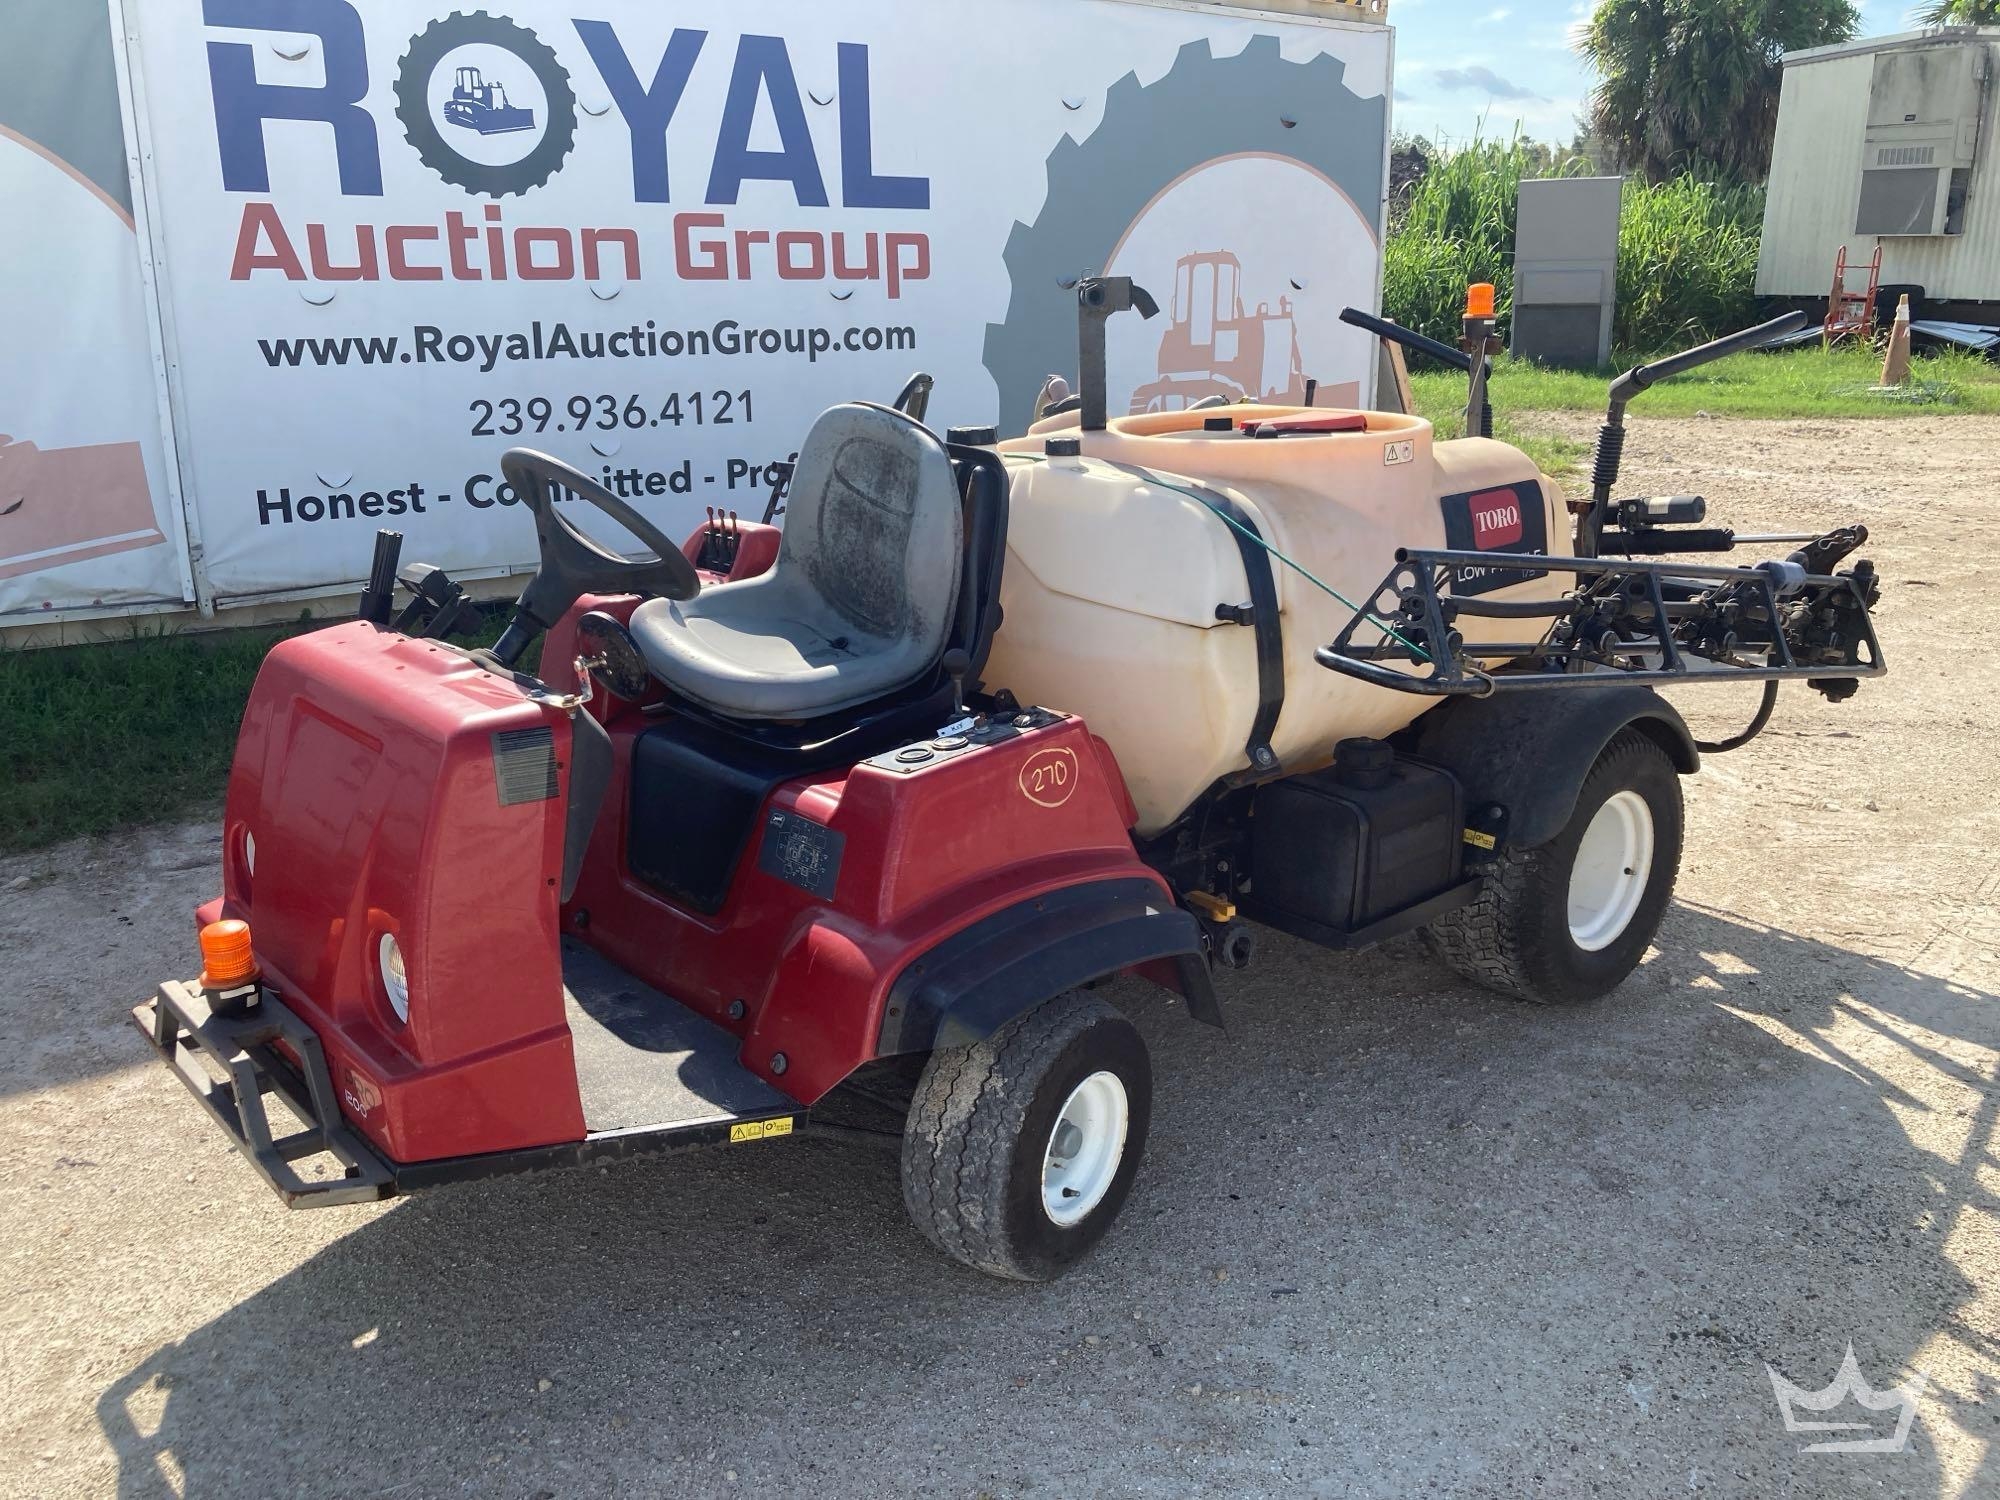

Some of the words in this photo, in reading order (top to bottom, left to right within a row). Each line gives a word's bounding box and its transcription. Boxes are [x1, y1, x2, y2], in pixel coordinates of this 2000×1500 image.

[203, 0, 930, 210] ROYAL
[229, 202, 641, 281] Auction
[673, 213, 930, 299] Group
[257, 320, 916, 372] www.RoyalAuctionGroup.com
[469, 390, 753, 436] 239.936.4121
[256, 483, 426, 525] Honest
[464, 460, 692, 509] Coitted
[1475, 505, 1518, 532] TORO
[1457, 566, 1486, 582] LOW
[1031, 761, 1067, 792] 270
[344, 1088, 368, 1119] 1200
